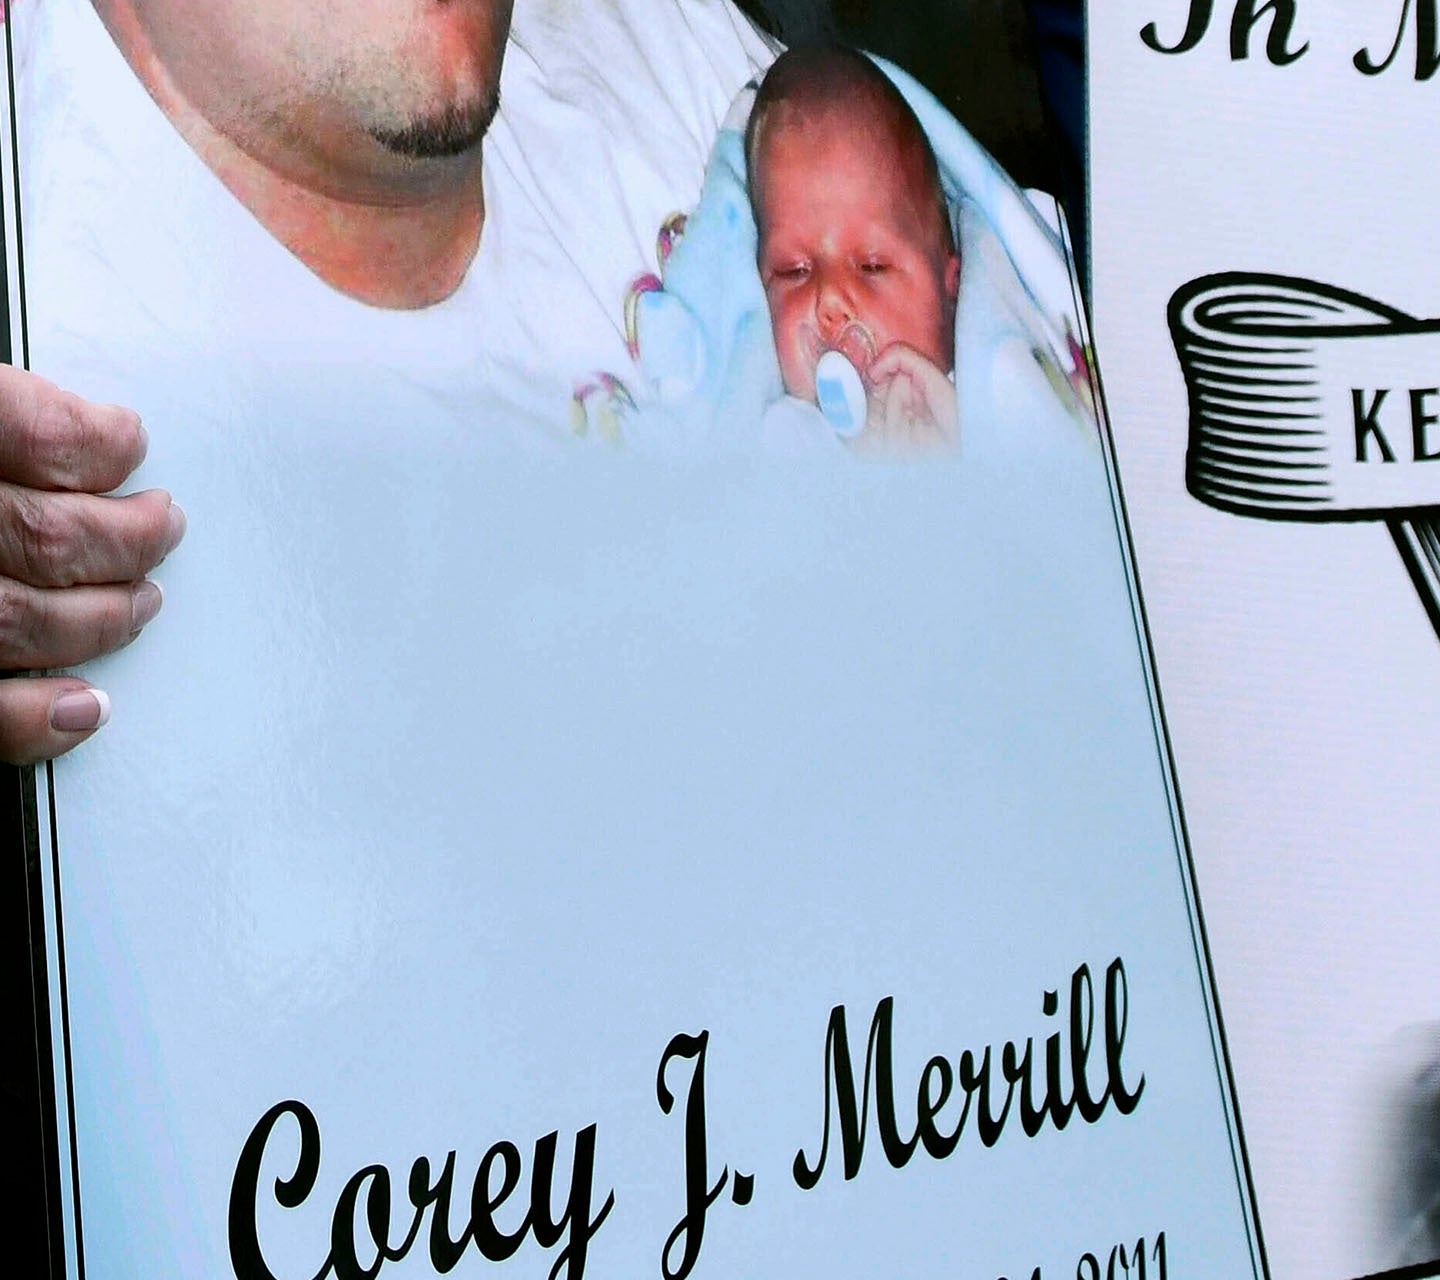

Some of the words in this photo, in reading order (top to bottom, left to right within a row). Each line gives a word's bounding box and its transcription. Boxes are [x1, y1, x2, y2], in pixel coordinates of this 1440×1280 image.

[227, 1099, 616, 1280] Corey
[656, 1029, 757, 1280] J.
[793, 955, 1146, 1195] Merrill
